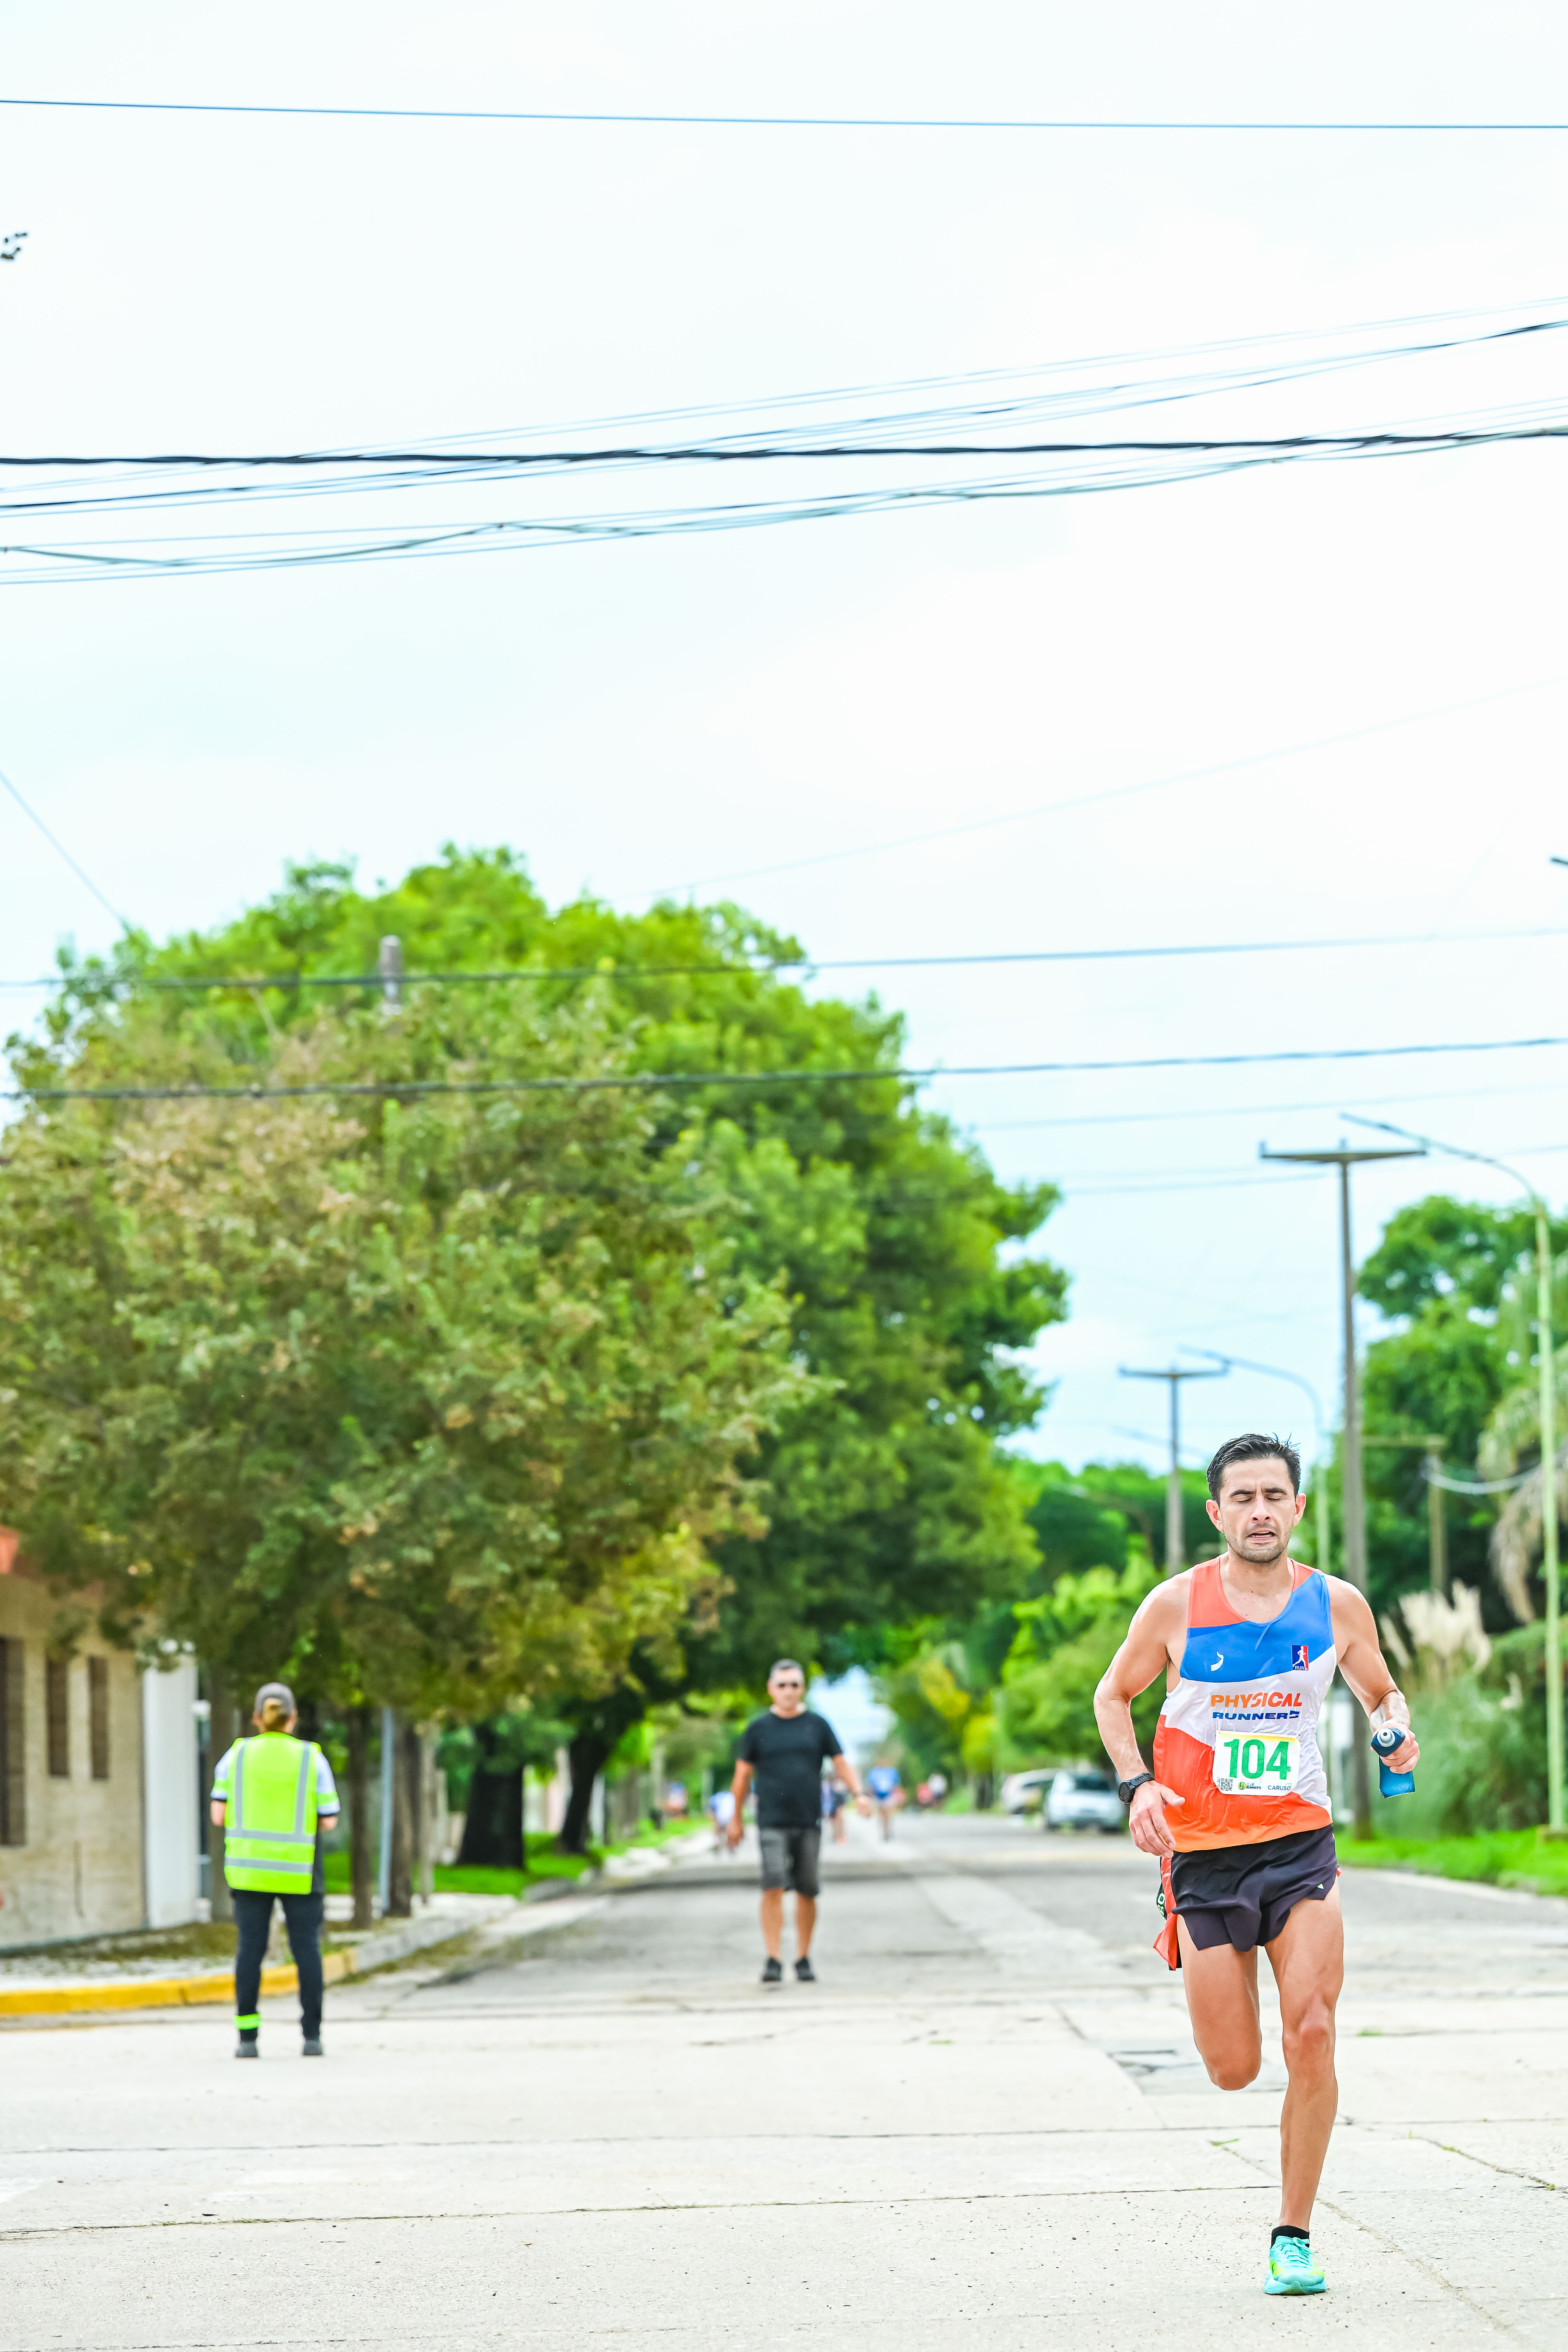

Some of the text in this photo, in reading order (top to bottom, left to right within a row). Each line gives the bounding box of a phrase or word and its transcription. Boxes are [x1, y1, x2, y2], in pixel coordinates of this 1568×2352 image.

[1211, 1692, 1302, 1708] PHYSICAL
[1213, 1710, 1300, 1720] RUNNERS
[1224, 1739, 1291, 1780] 104
